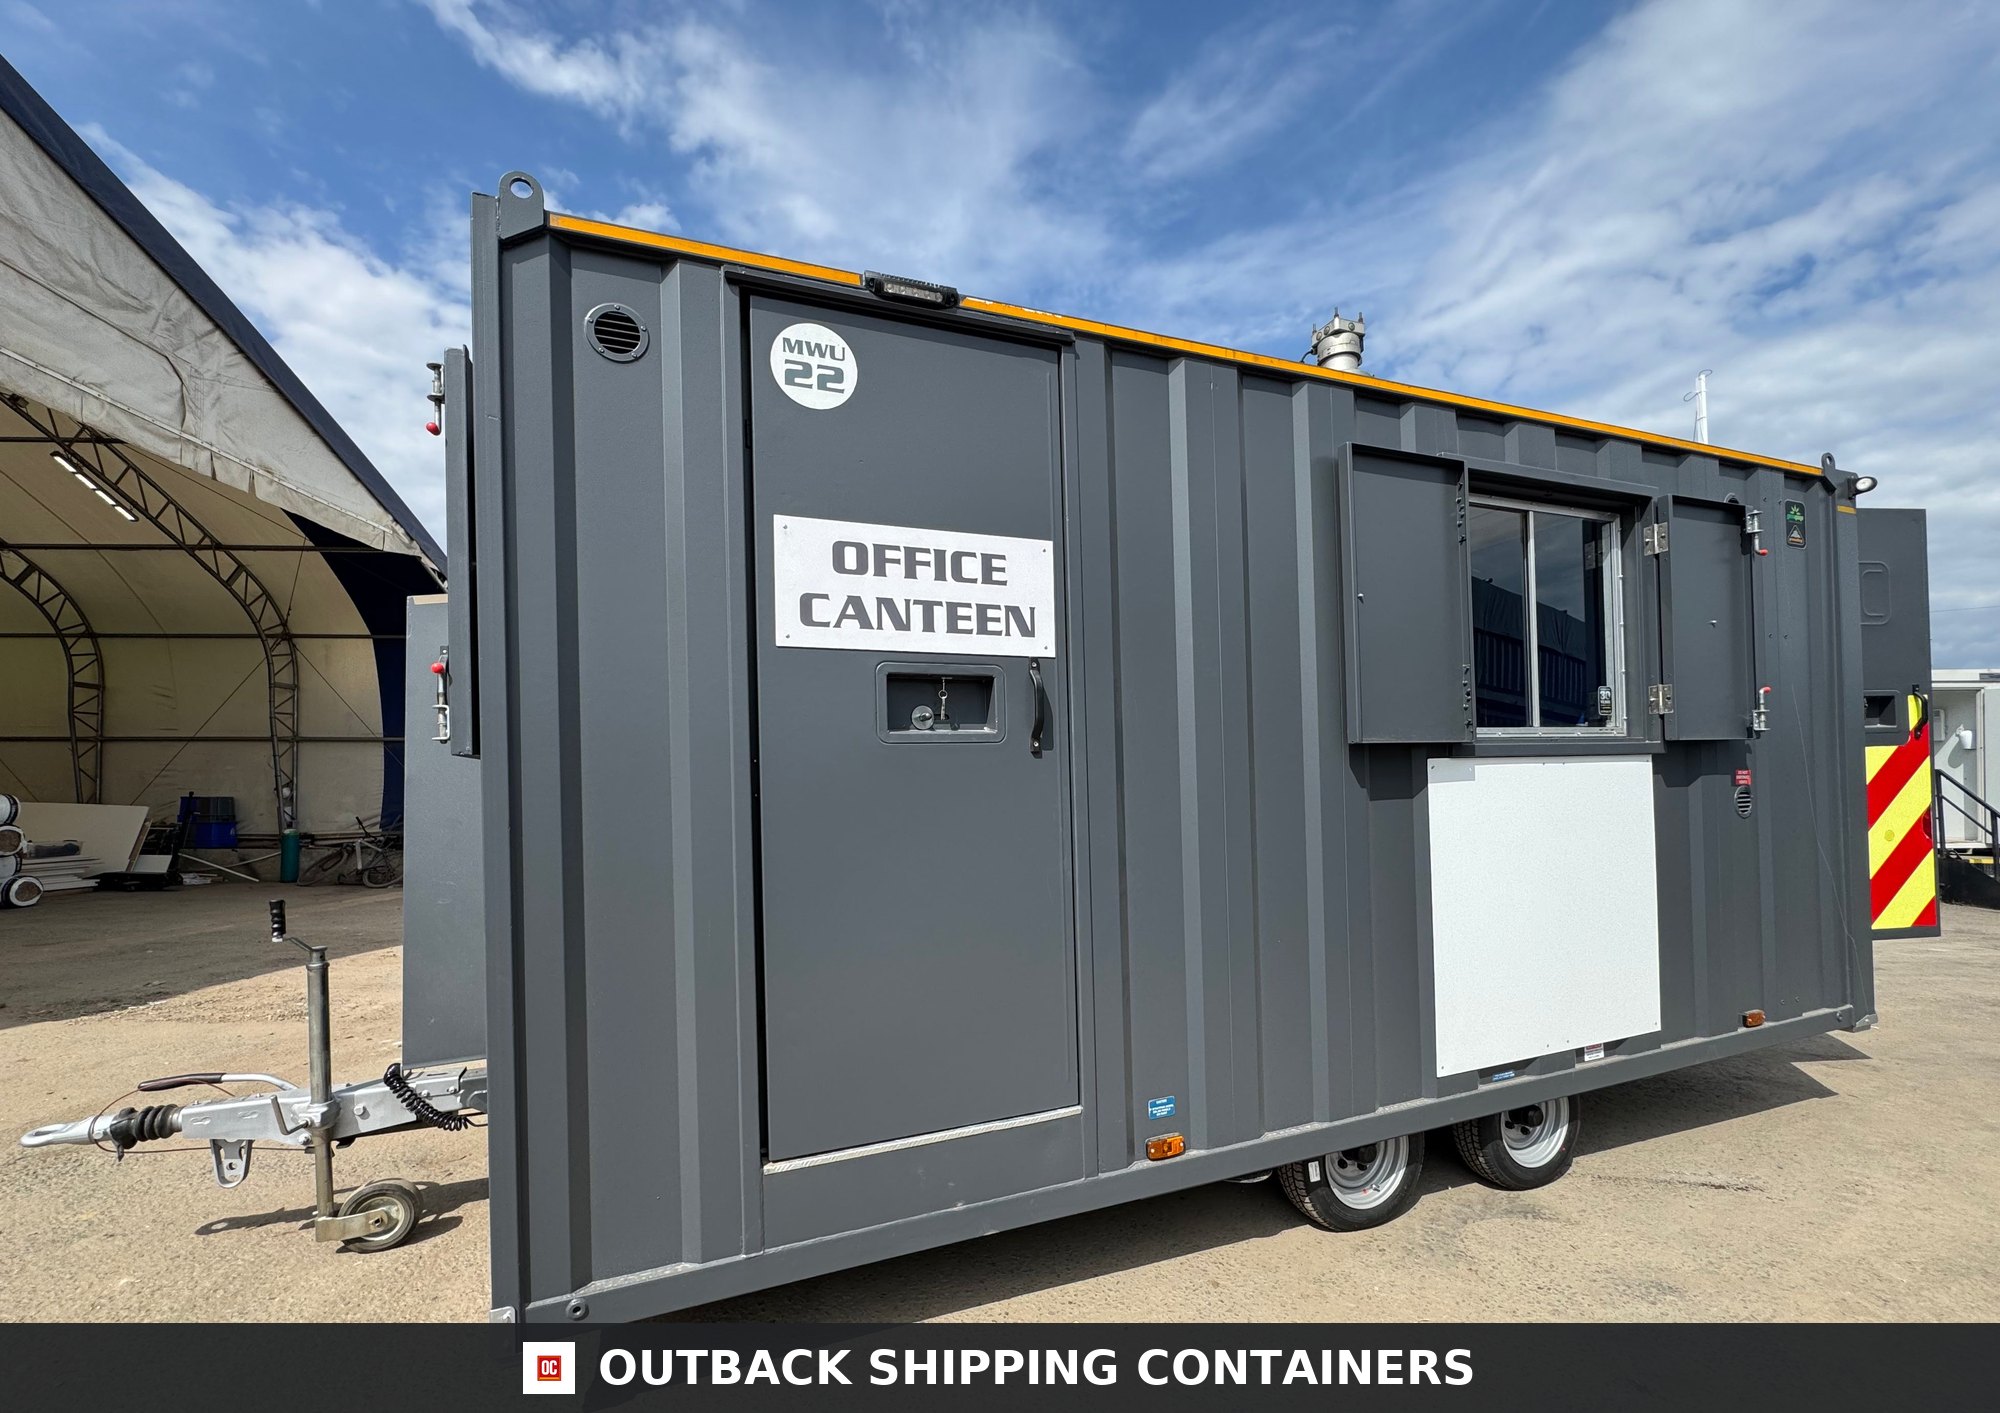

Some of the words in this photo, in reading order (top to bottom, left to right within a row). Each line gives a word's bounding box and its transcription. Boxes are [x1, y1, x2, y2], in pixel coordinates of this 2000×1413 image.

[782, 337, 845, 361] MWU
[784, 359, 845, 394] 22
[832, 540, 1008, 586] OFFICE
[799, 592, 1036, 638] CANTEEN
